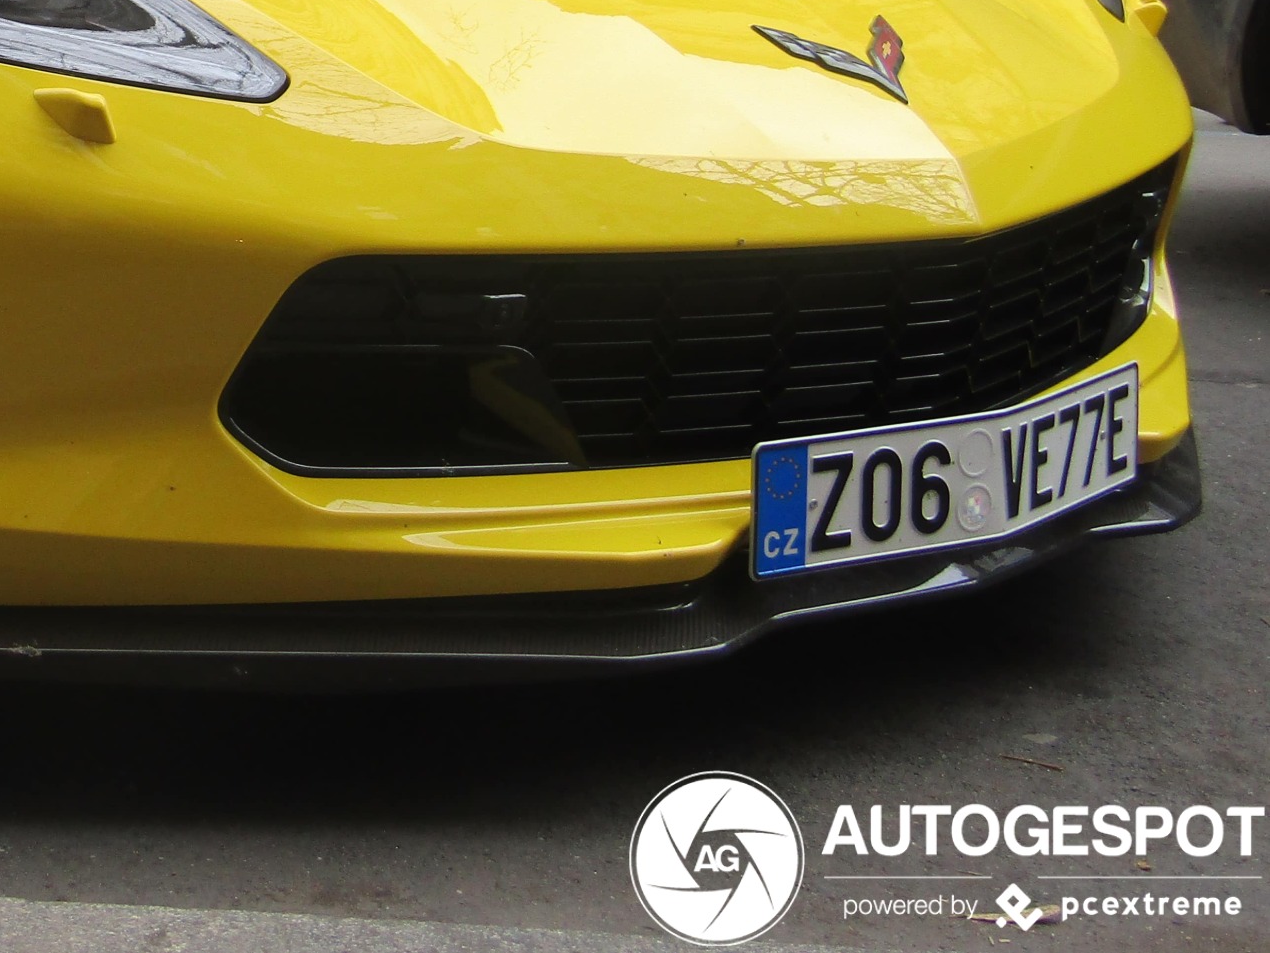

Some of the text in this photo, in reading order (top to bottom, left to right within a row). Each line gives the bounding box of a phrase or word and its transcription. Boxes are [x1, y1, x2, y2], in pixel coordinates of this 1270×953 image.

[810, 384, 1129, 552] Z06 VE77E
[763, 526, 799, 558] CZ
